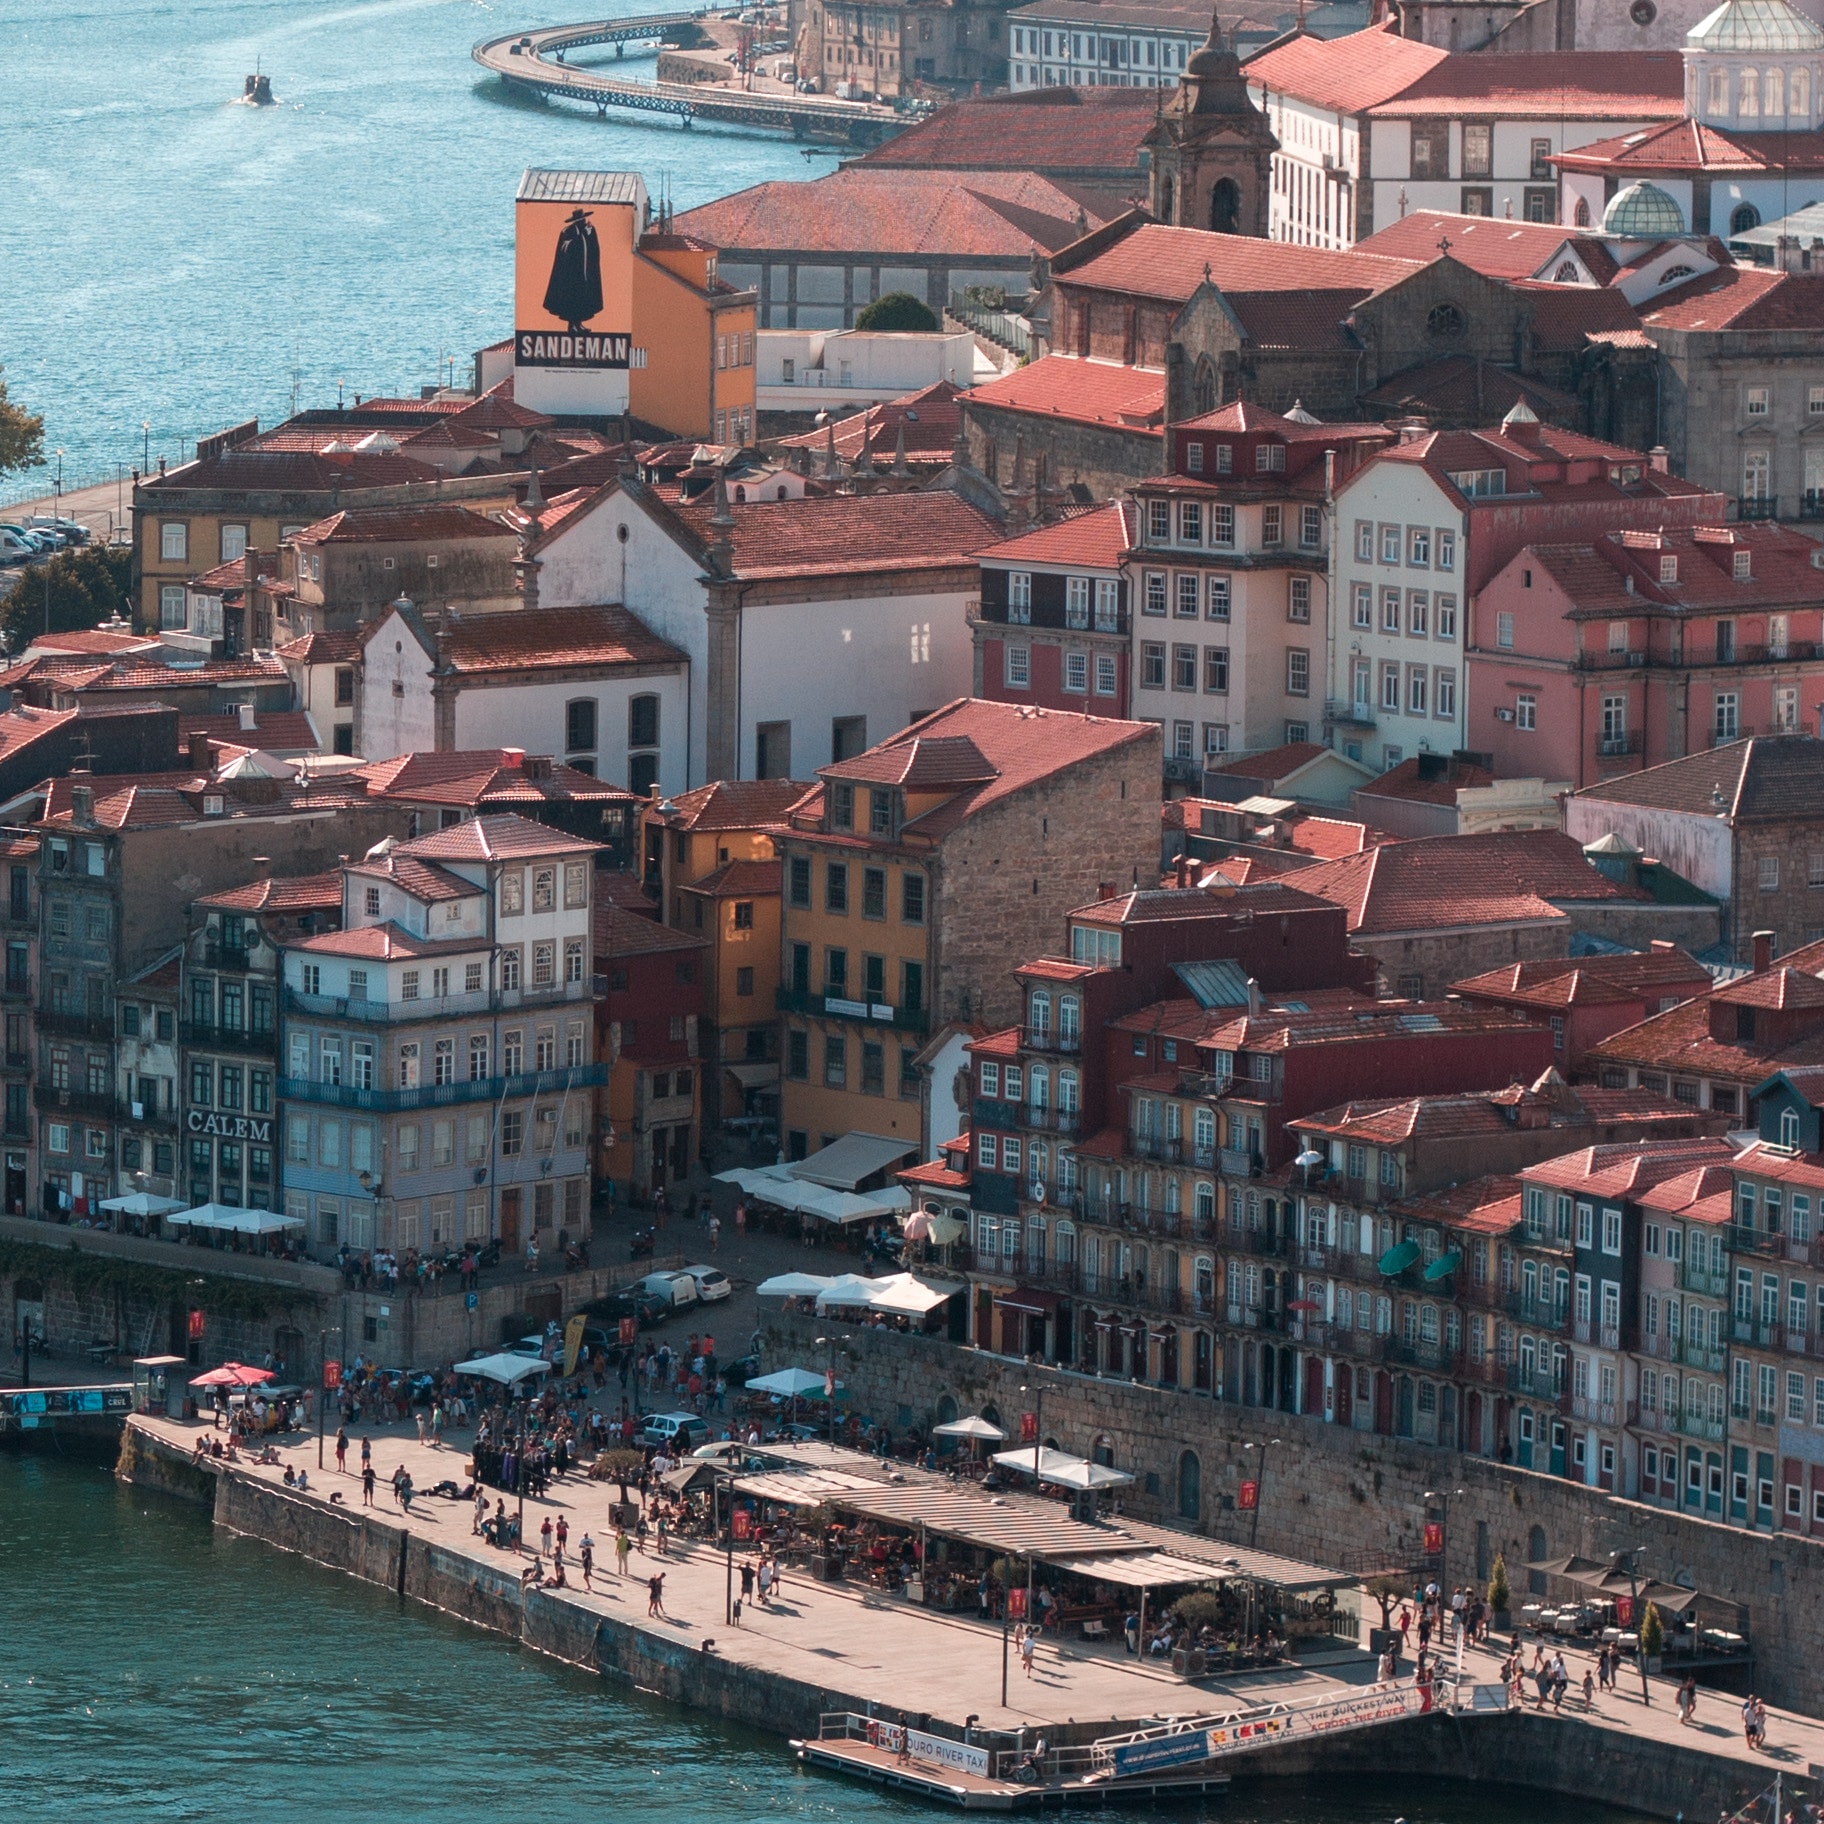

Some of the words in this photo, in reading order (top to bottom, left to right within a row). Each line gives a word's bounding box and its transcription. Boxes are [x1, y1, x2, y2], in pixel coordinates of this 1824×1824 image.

[521, 335, 627, 360] SANDEMAN
[187, 1111, 270, 1142] CÁLEM
[469, 1294, 476, 1306] P
[1309, 1710, 1330, 1720] THE
[1331, 1699, 1381, 1716] QUICKEST
[1384, 1693, 1406, 1705] WAY
[1311, 1717, 1351, 1732] ACROSS
[1354, 1713, 1373, 1723] THE
[1375, 1706, 1406, 1719] RIVER
[907, 1737, 933, 1755] OURO
[936, 1745, 964, 1764] RIVER
[966, 1753, 987, 1771] TAXI
